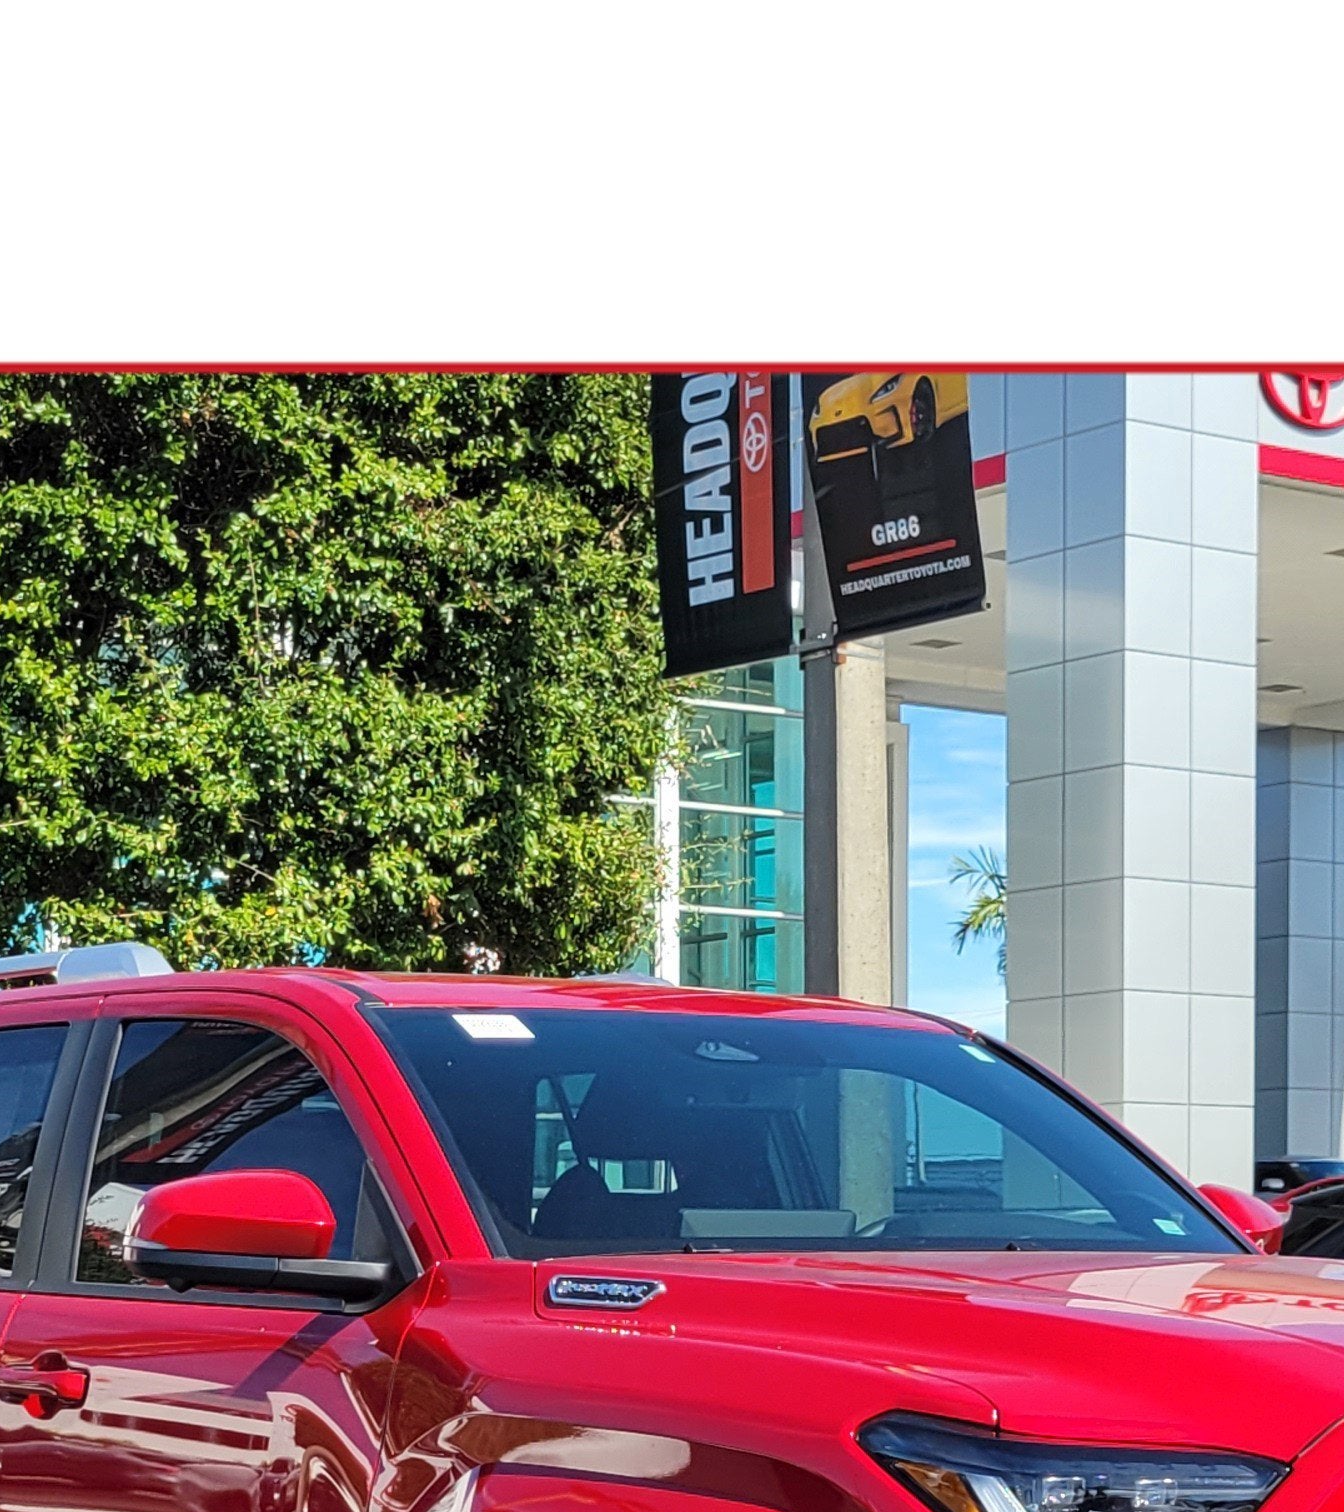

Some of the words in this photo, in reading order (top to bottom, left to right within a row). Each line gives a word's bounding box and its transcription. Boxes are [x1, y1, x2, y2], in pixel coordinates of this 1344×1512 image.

[681, 374, 738, 608] HEADQ
[870, 514, 921, 547] GR86
[839, 554, 972, 597] HEADQUARTERTOYOTA.COM
